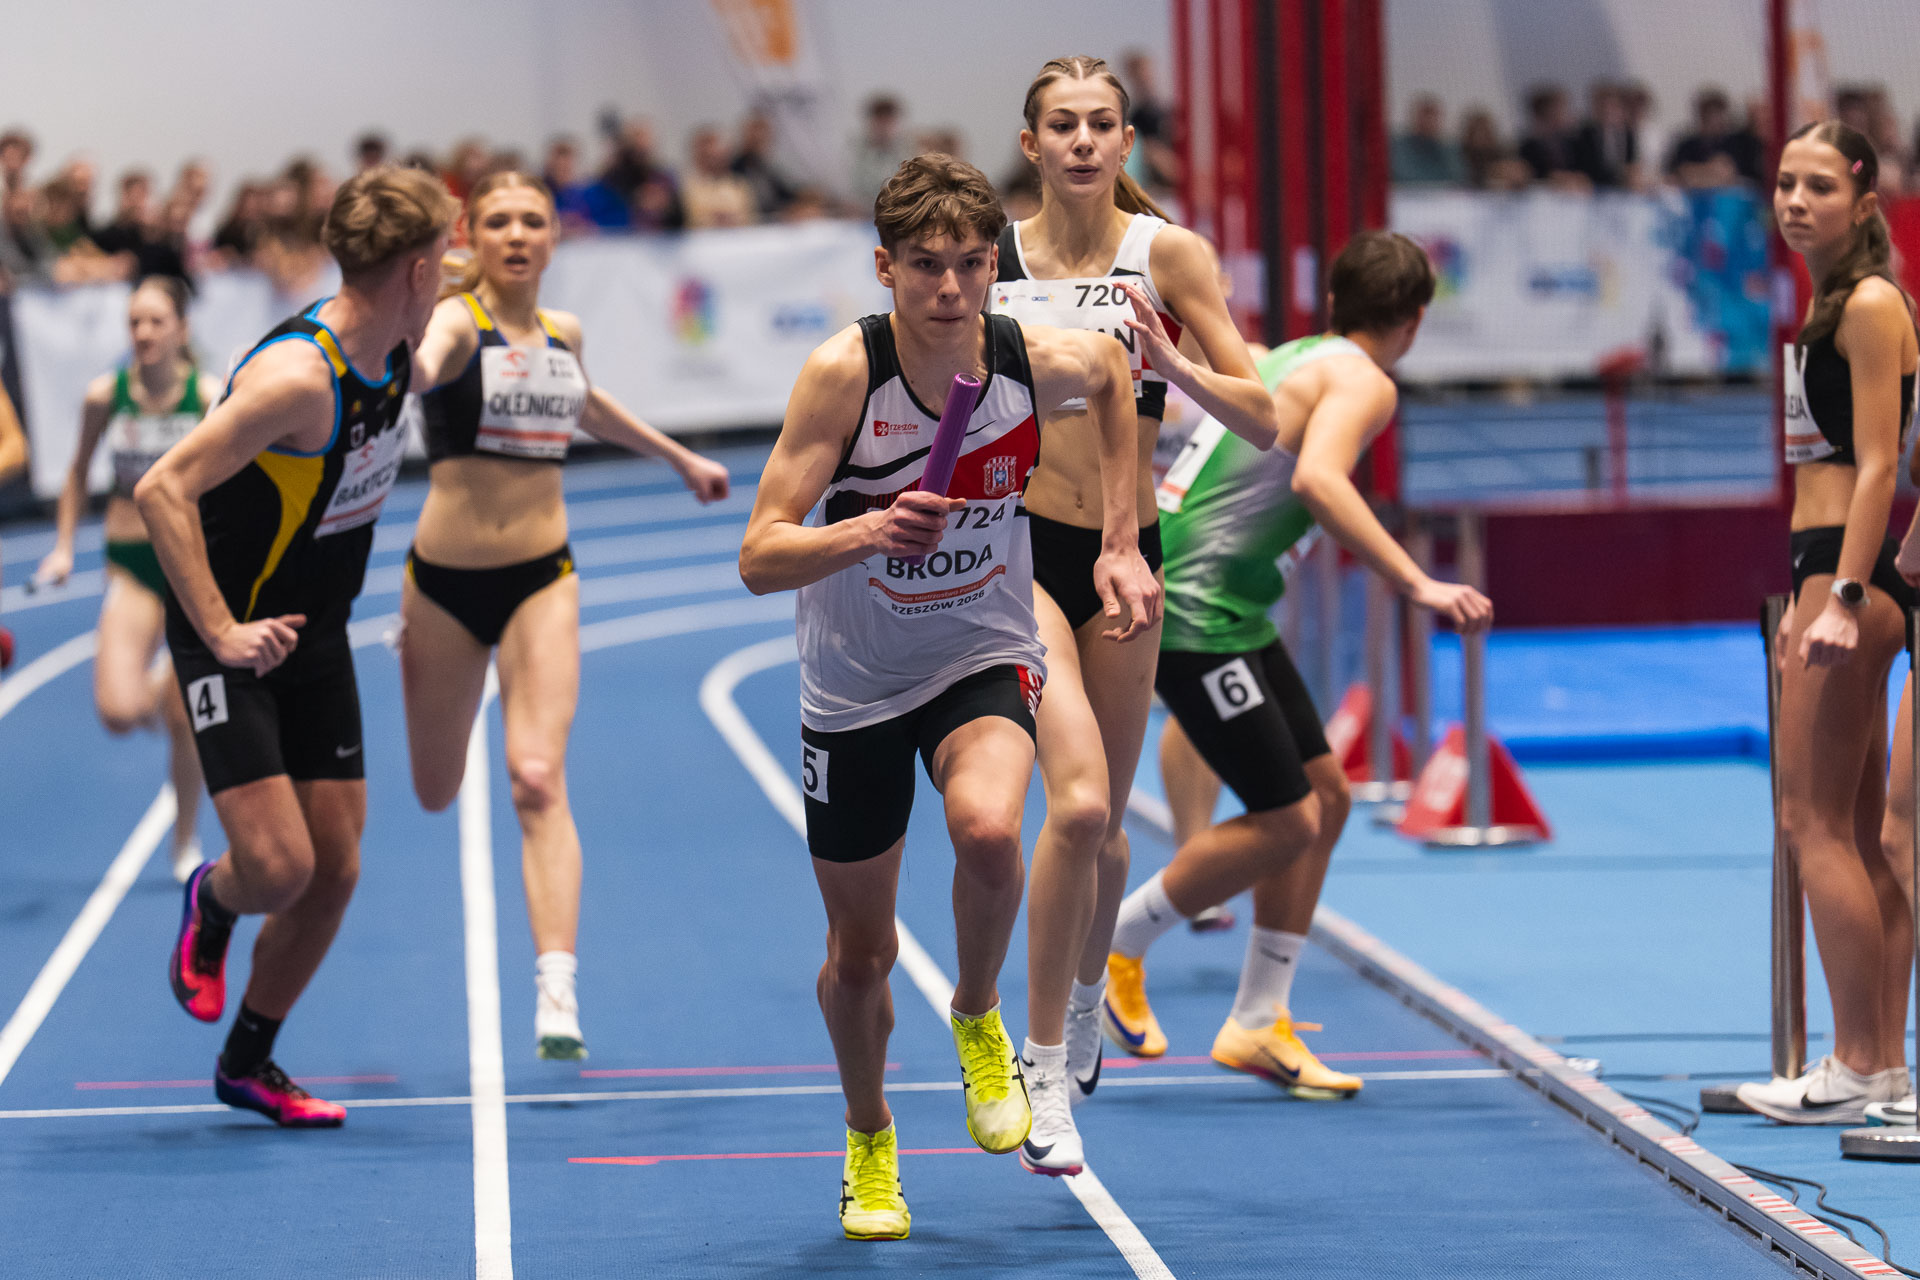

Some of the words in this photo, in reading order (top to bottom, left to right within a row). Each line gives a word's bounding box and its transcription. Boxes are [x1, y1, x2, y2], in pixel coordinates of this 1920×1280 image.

[1075, 284, 1128, 307] 720
[954, 502, 1006, 530] 724
[886, 543, 993, 580] BRODA
[891, 601, 955, 615] RZESZÓW
[957, 589, 985, 607] 2026
[197, 682, 217, 720] 4
[1219, 670, 1249, 707] 6
[803, 745, 819, 793] 5
